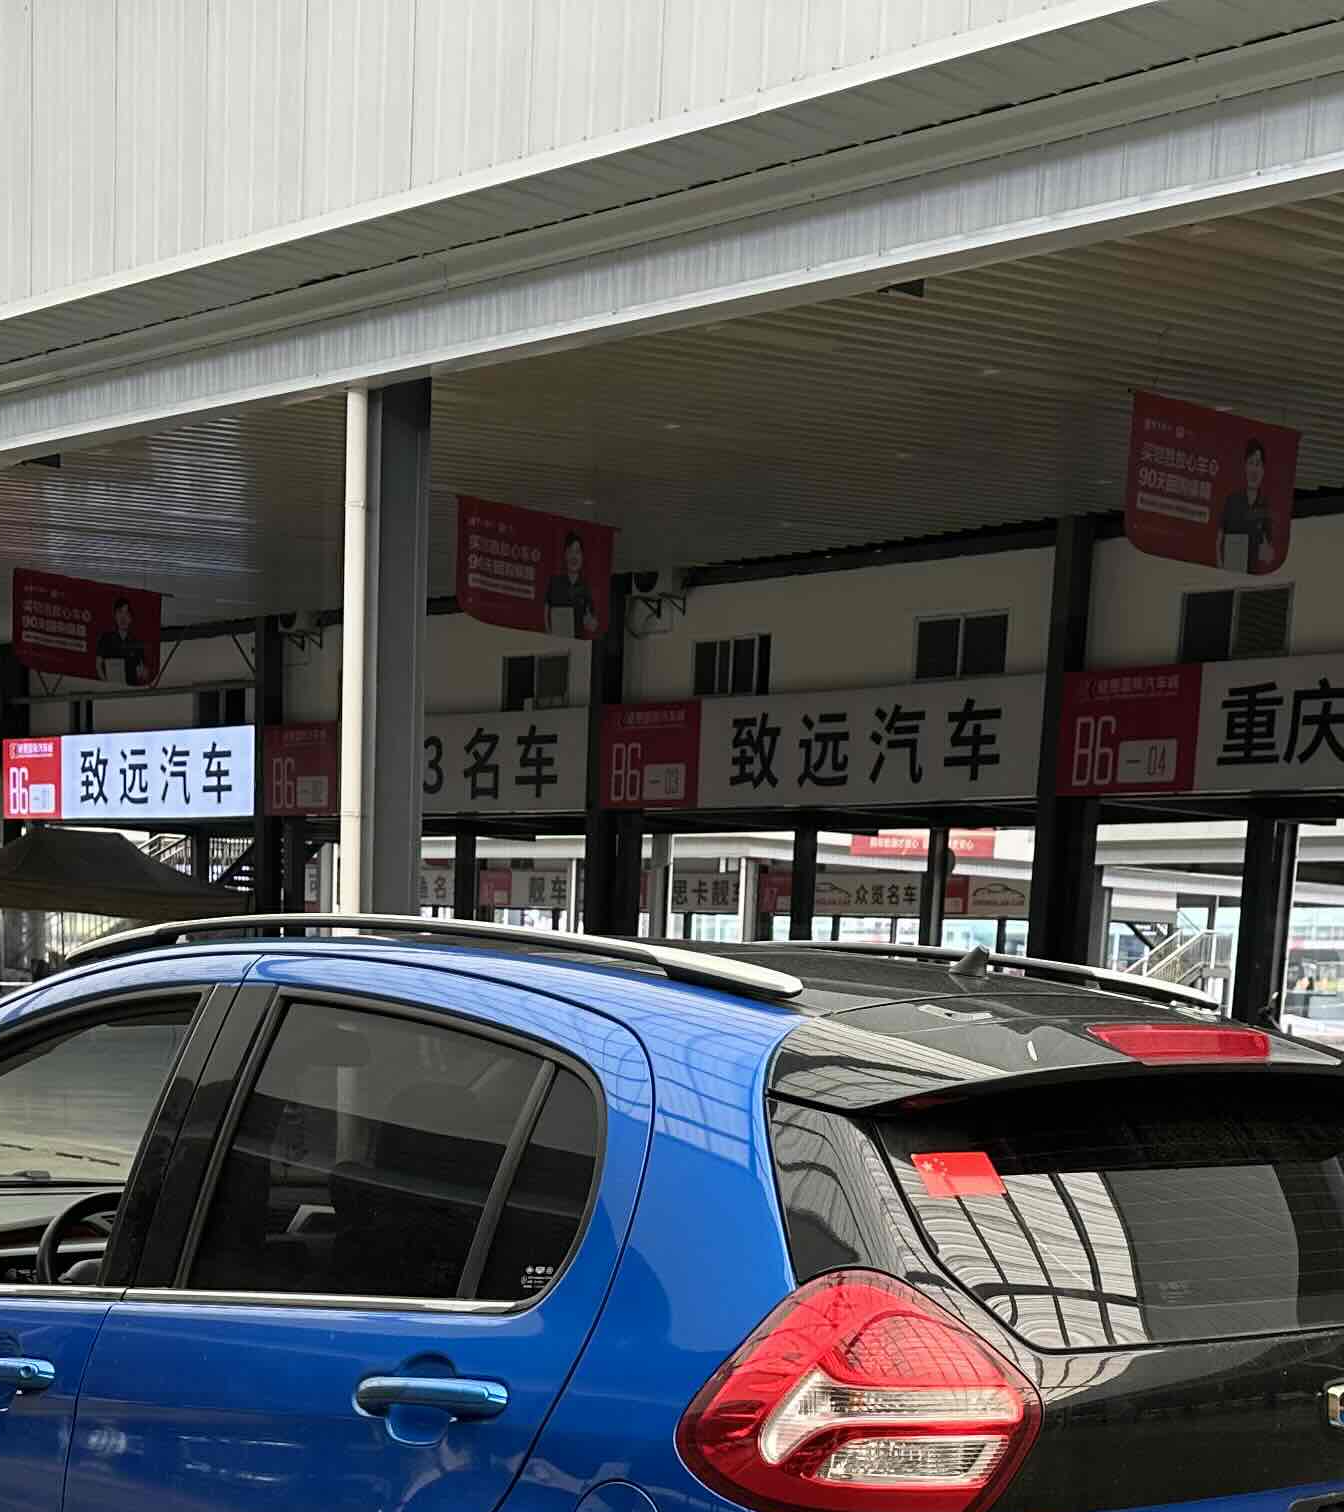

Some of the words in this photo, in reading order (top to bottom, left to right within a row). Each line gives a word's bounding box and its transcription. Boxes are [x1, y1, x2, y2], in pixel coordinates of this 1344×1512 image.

[79, 741, 233, 806] 致远汽车
[730, 698, 1002, 789] 致远汽车
